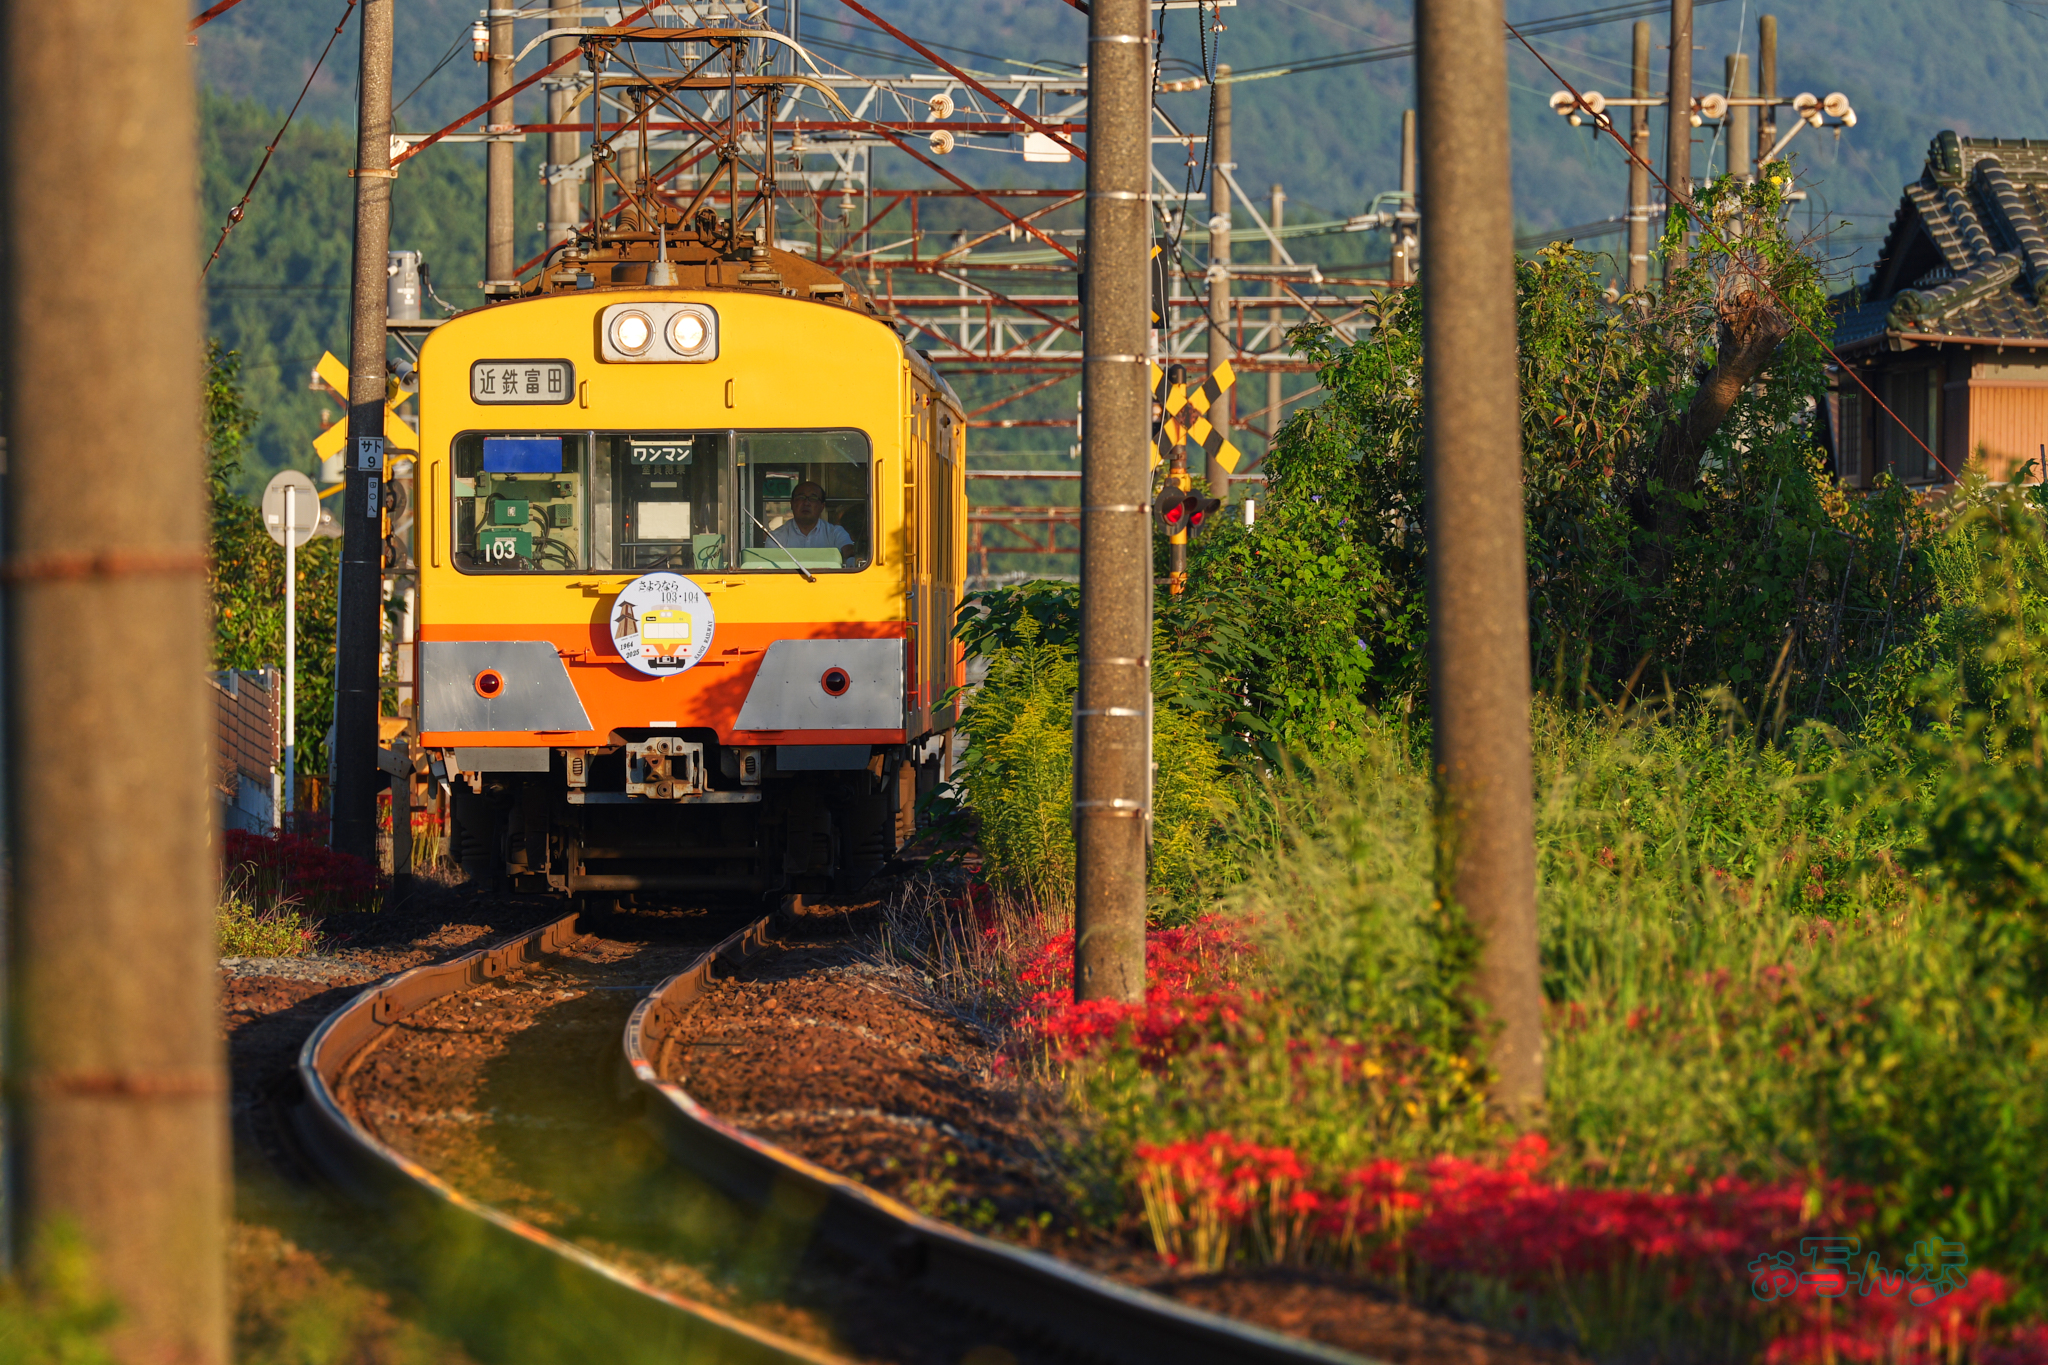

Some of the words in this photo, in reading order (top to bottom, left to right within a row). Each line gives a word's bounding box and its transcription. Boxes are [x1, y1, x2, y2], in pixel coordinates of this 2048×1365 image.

[480, 368, 562, 394] 近鉄富田
[361, 440, 381, 453] サト
[633, 447, 690, 462] ワンマン
[367, 456, 376, 468] 9
[485, 540, 516, 562] 103
[639, 580, 679, 592] さようなら
[703, 620, 713, 644] RAILWAY
[620, 641, 634, 651] 1964
[626, 649, 640, 659] 2025
